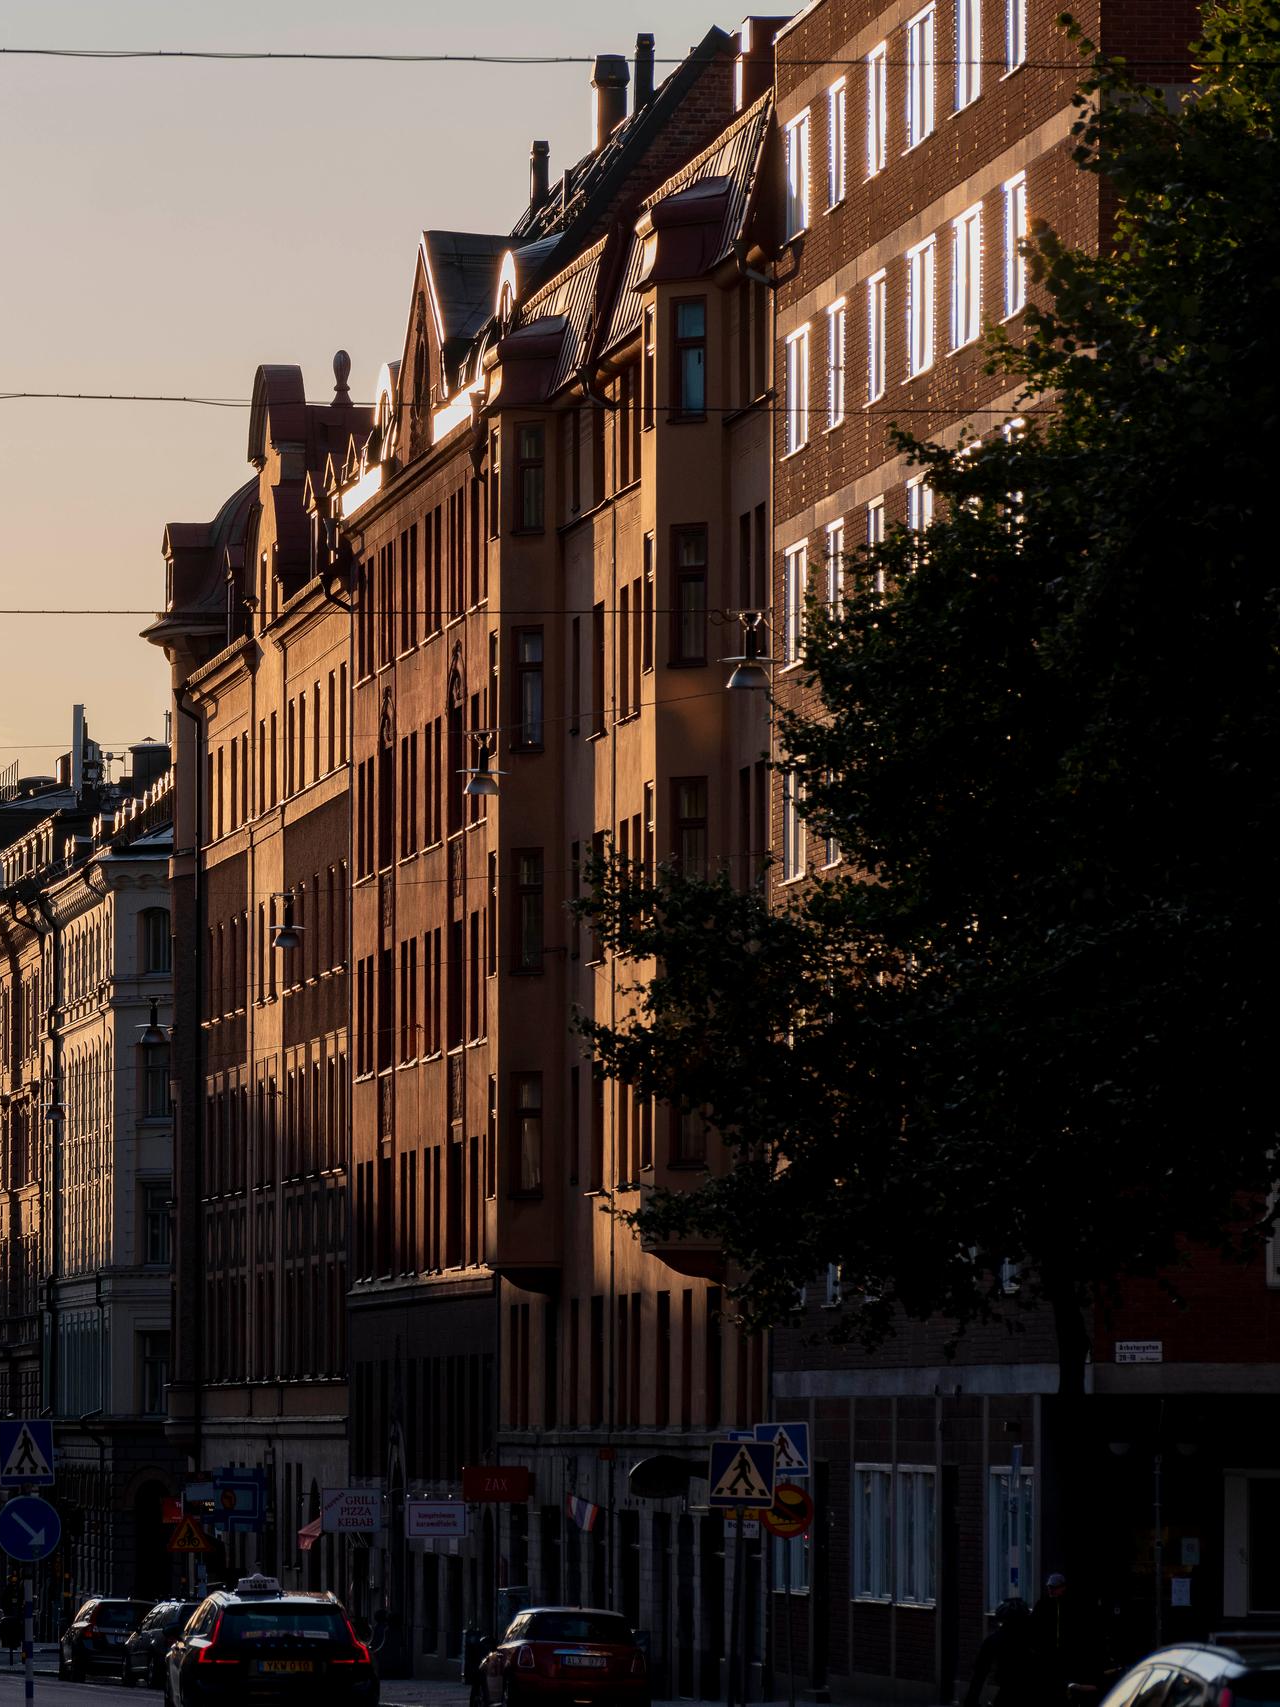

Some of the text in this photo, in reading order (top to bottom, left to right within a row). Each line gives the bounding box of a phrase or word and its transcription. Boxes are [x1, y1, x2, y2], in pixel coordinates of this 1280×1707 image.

[485, 1478, 508, 1492] ZAX
[345, 1496, 378, 1505] GRILL
[340, 1507, 371, 1516] PIZZA
[338, 1518, 374, 1528] KEBAB
